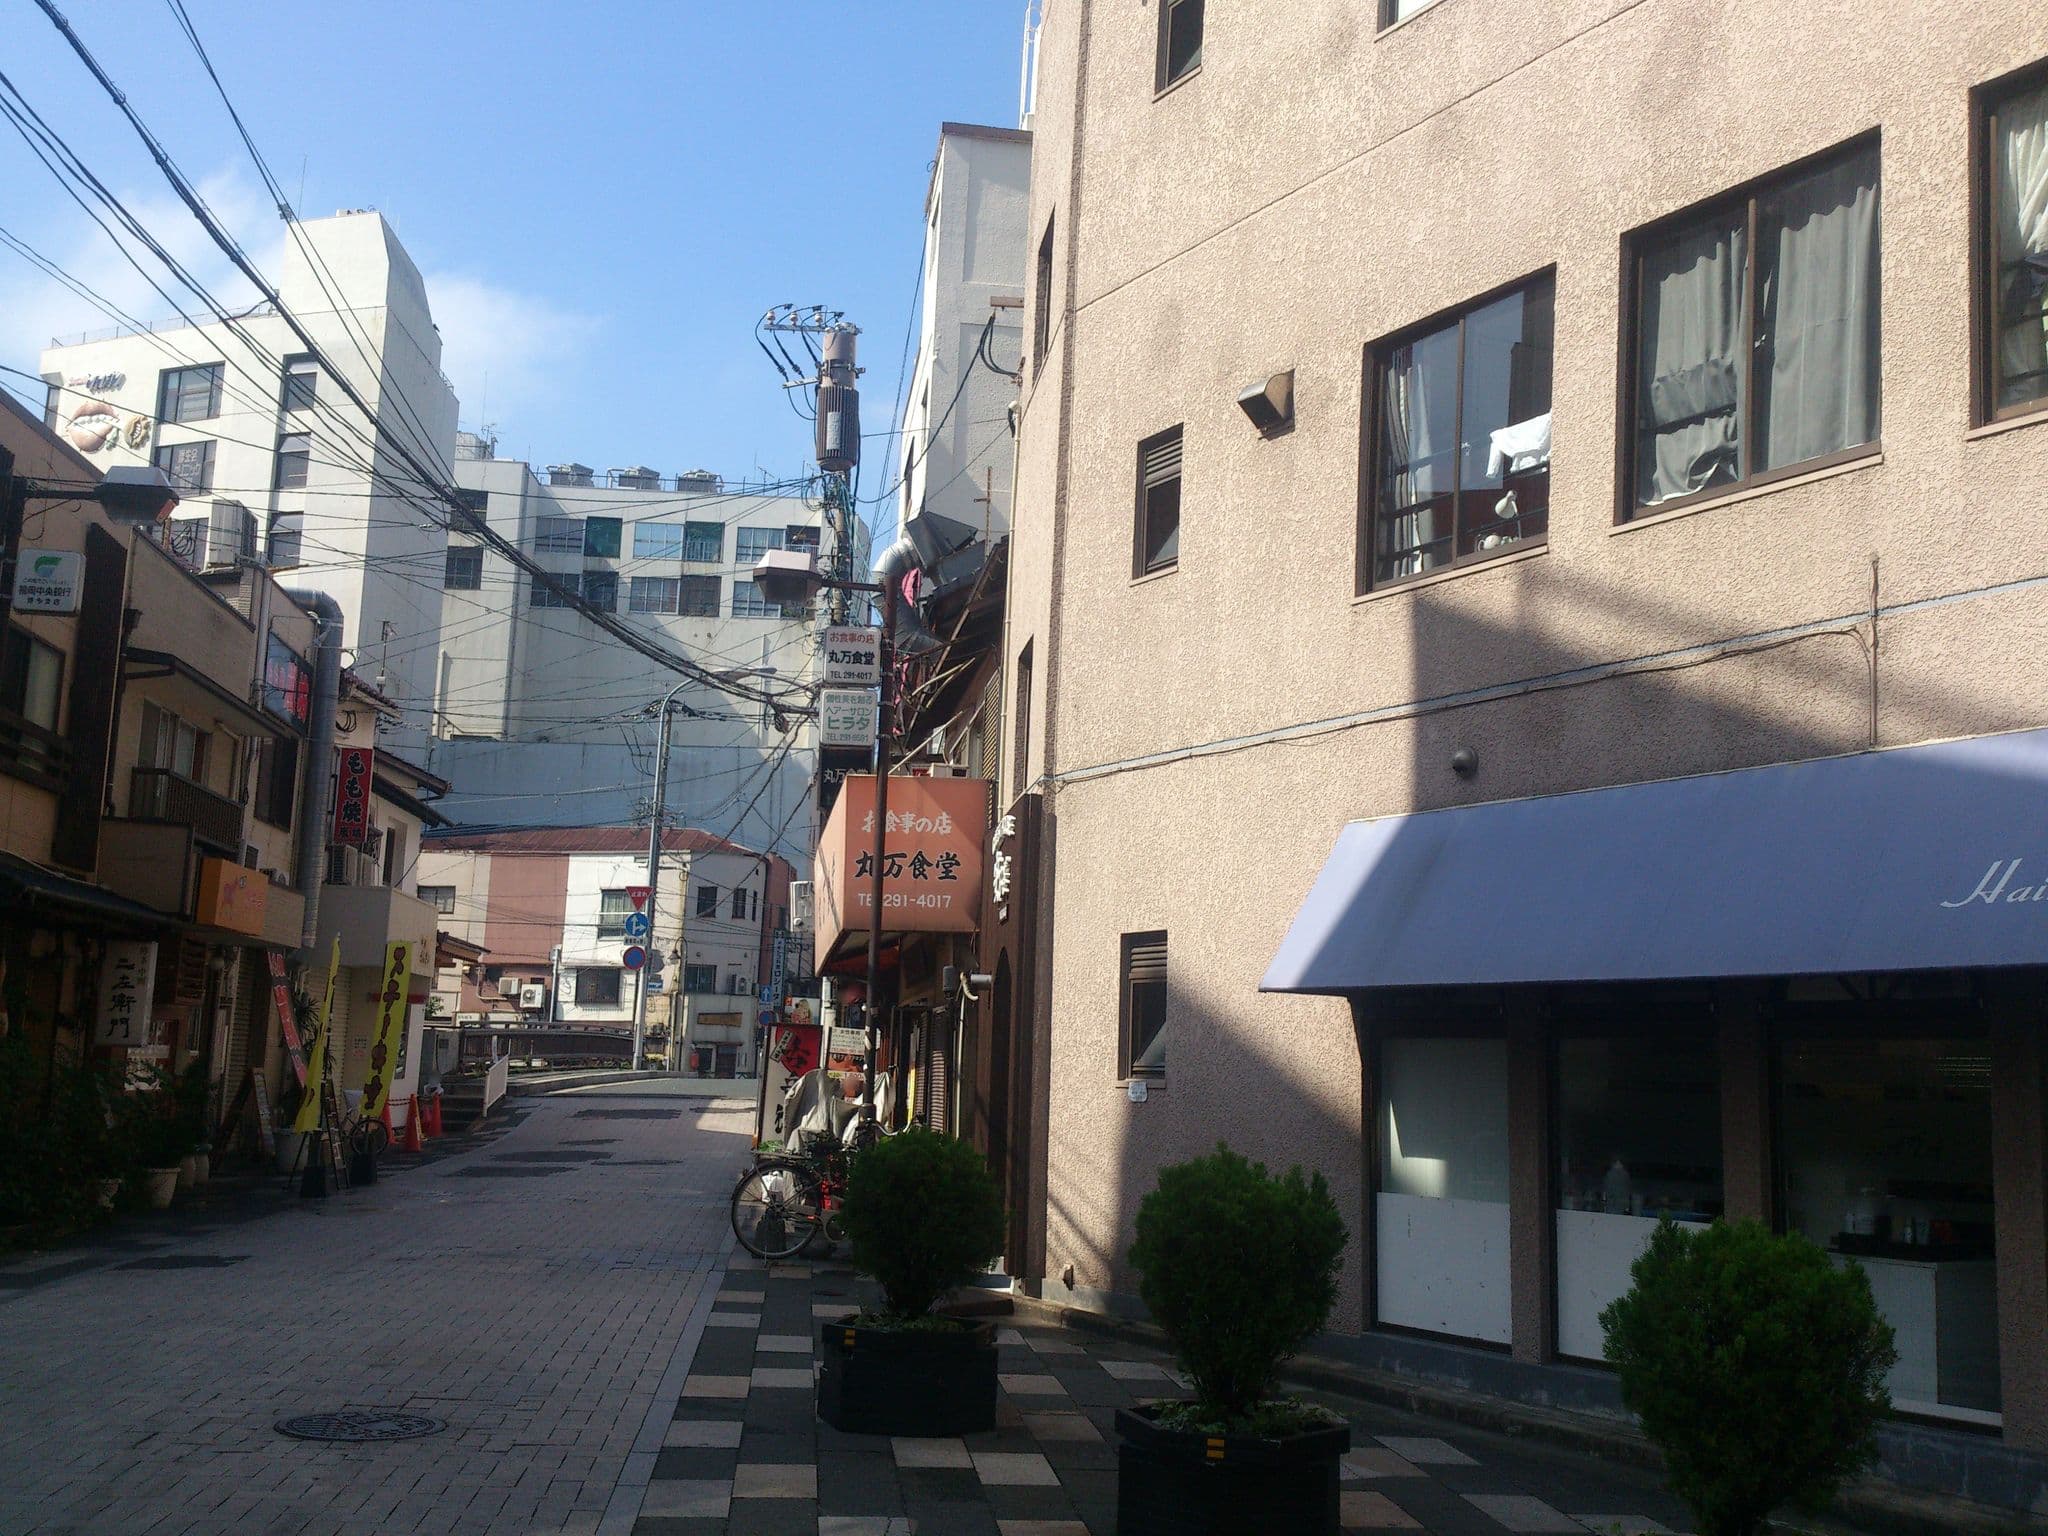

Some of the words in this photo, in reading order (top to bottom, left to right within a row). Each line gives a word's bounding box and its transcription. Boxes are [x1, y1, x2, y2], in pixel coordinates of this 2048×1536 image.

[830, 632, 875, 644] お食事の店
[828, 650, 875, 665] 丸万食堂
[830, 670, 841, 679] TEL
[826, 706, 872, 716] ヘアーサロン
[828, 716, 870, 730] ヒラタ
[855, 850, 961, 880] 丸万食堂
[1940, 858, 2048, 908] Hai
[858, 893, 875, 907] TE
[882, 893, 952, 908] 291-4017
